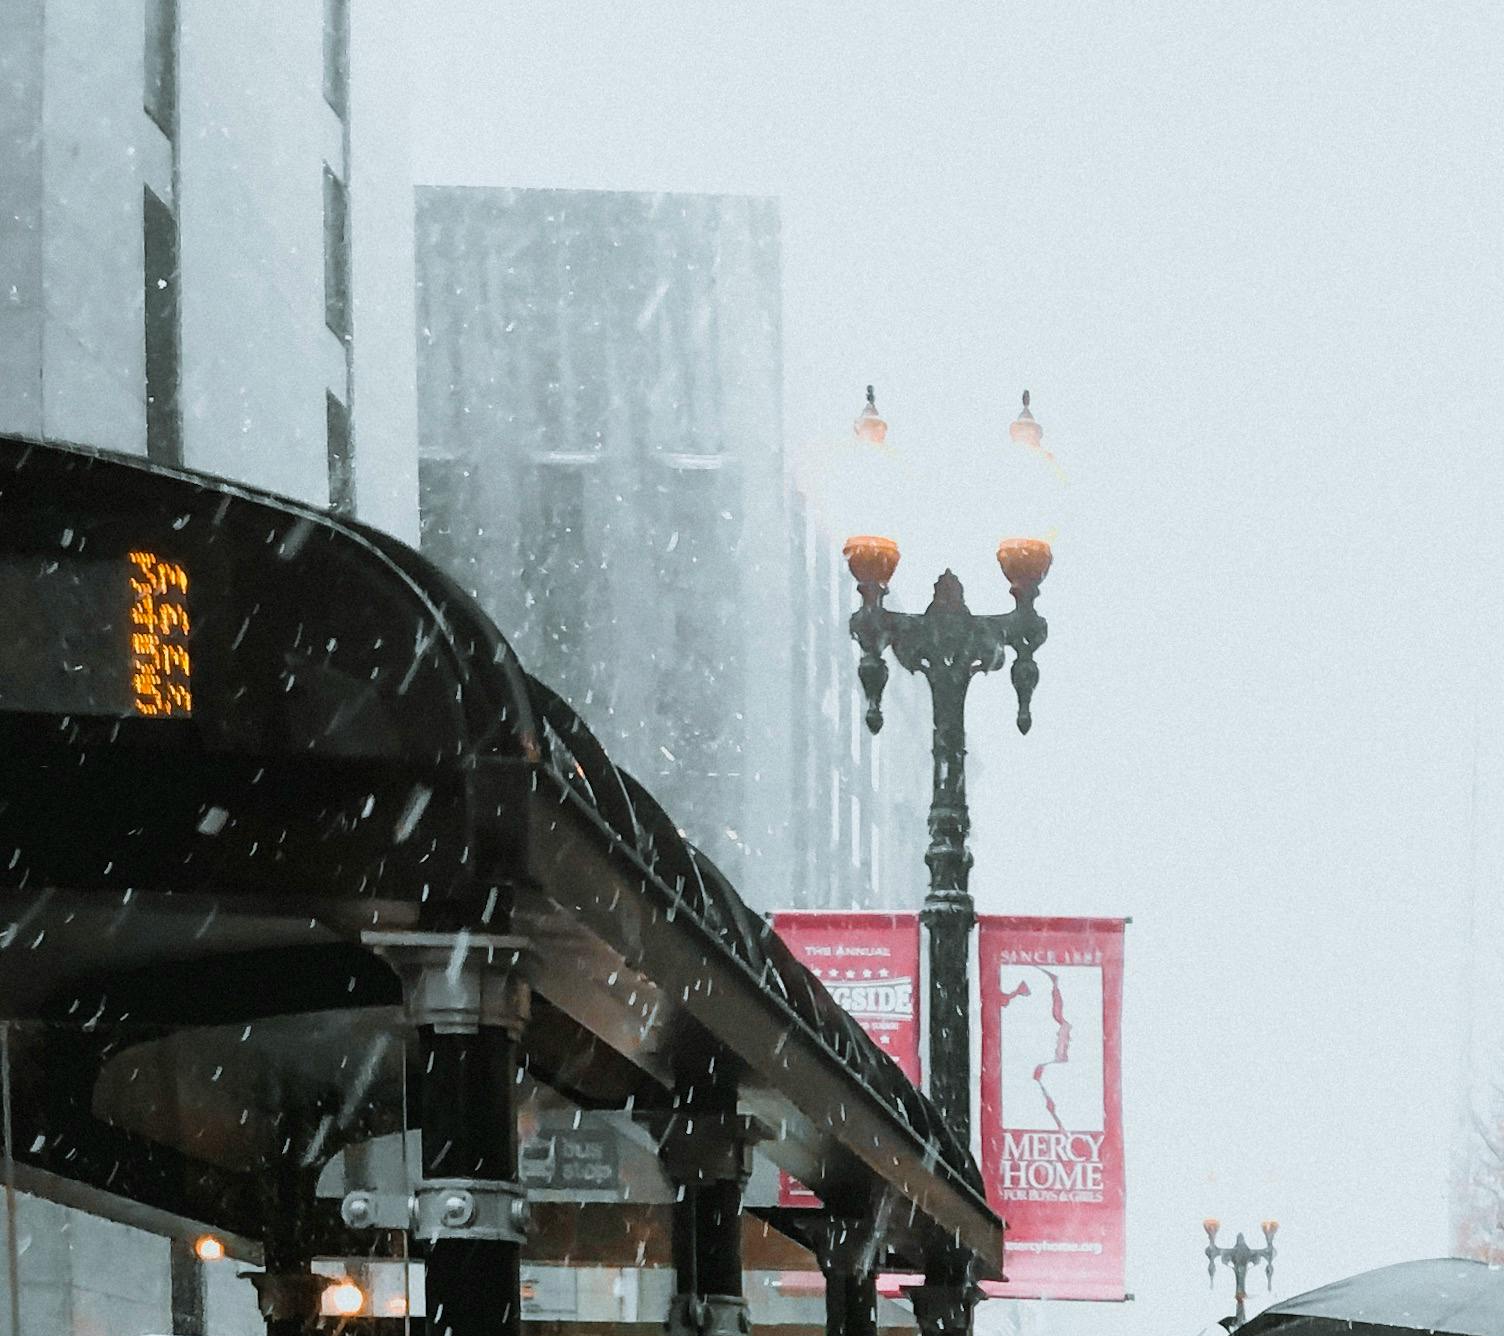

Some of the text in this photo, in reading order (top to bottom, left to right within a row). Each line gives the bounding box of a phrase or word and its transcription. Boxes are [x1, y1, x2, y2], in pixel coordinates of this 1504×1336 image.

[805, 946, 832, 957] THE
[1000, 949, 1057, 963] SINCE
[562, 1140, 604, 1159] bus
[1001, 1132, 1105, 1163] MERCY
[562, 1161, 612, 1185] stop
[1001, 1160, 1104, 1191] HOME
[1004, 1240, 1103, 1256] mercyhome.org
